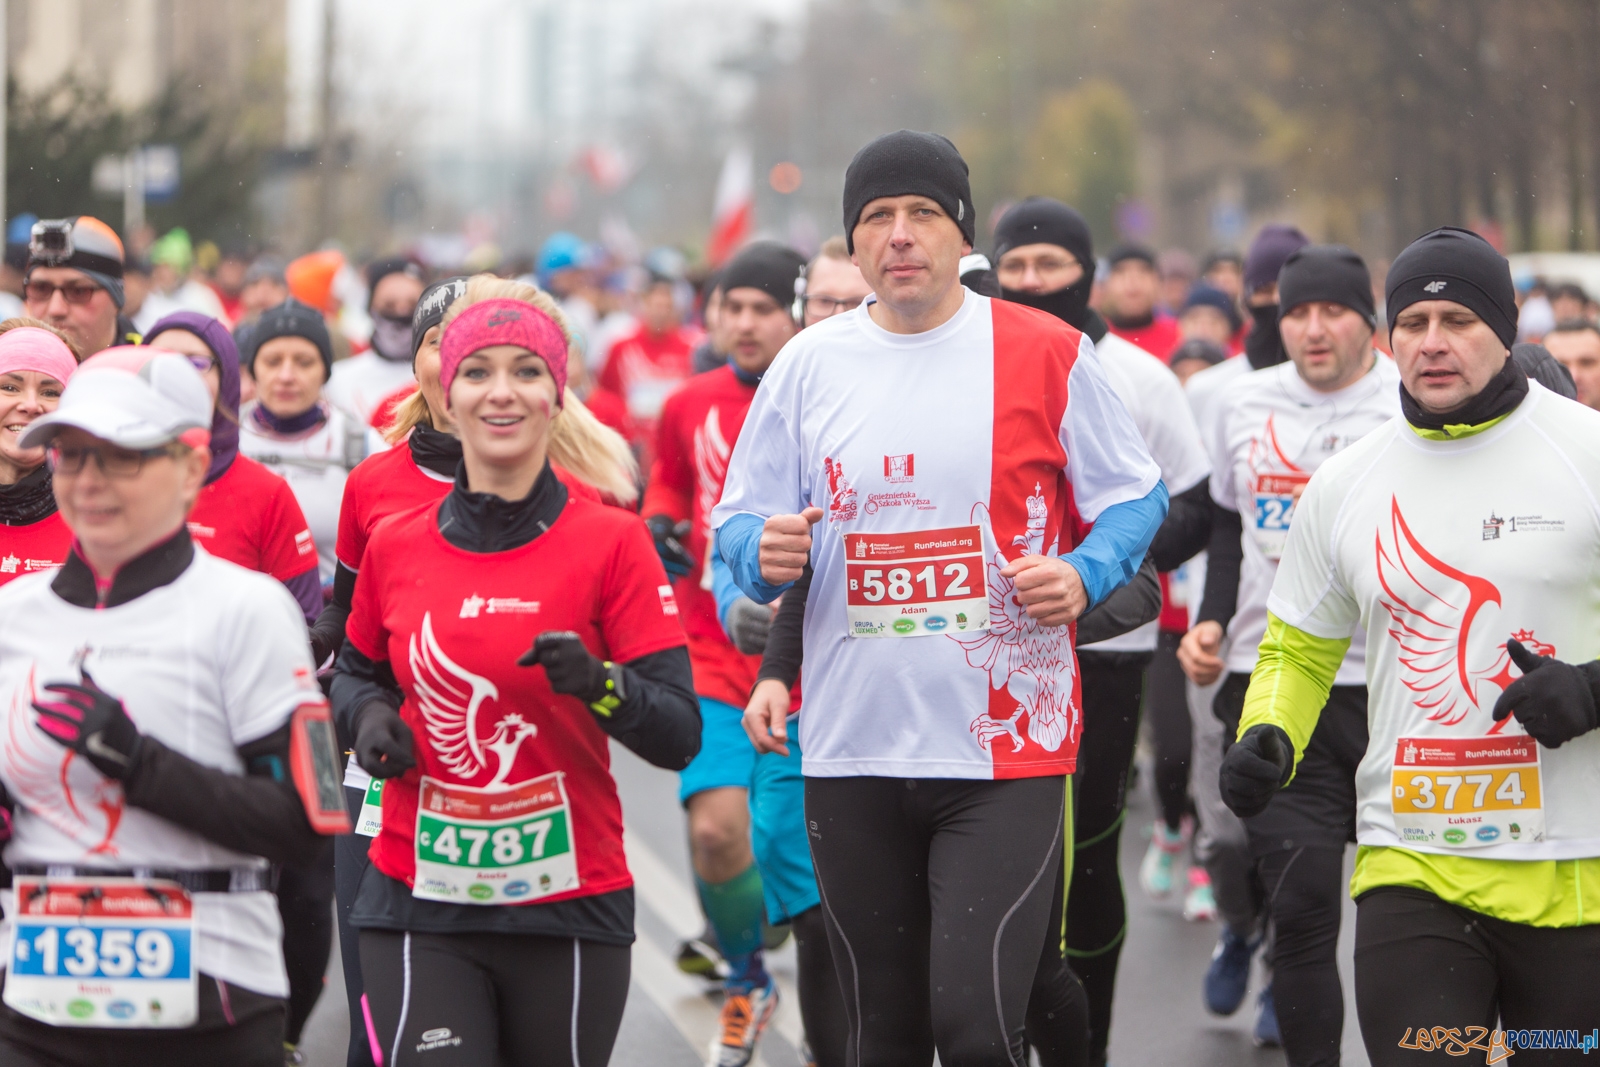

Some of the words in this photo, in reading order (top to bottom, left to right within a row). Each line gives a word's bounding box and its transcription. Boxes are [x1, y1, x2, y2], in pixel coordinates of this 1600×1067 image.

[1423, 281, 1447, 293] 4F
[914, 538, 973, 550] RunPoland.org
[850, 579, 859, 591] B
[862, 562, 971, 602] 5812
[901, 607, 928, 615] Adam
[1465, 747, 1528, 759] RunPoland.org
[372, 780, 382, 792] C
[1394, 785, 1405, 798] D
[1410, 771, 1526, 811] 3774
[1448, 816, 1483, 825] Łukasz
[1403, 827, 1425, 835] GRUPA
[433, 817, 553, 866] 4787
[1403, 834, 1429, 842] LUXMED
[34, 925, 175, 979] 1359
